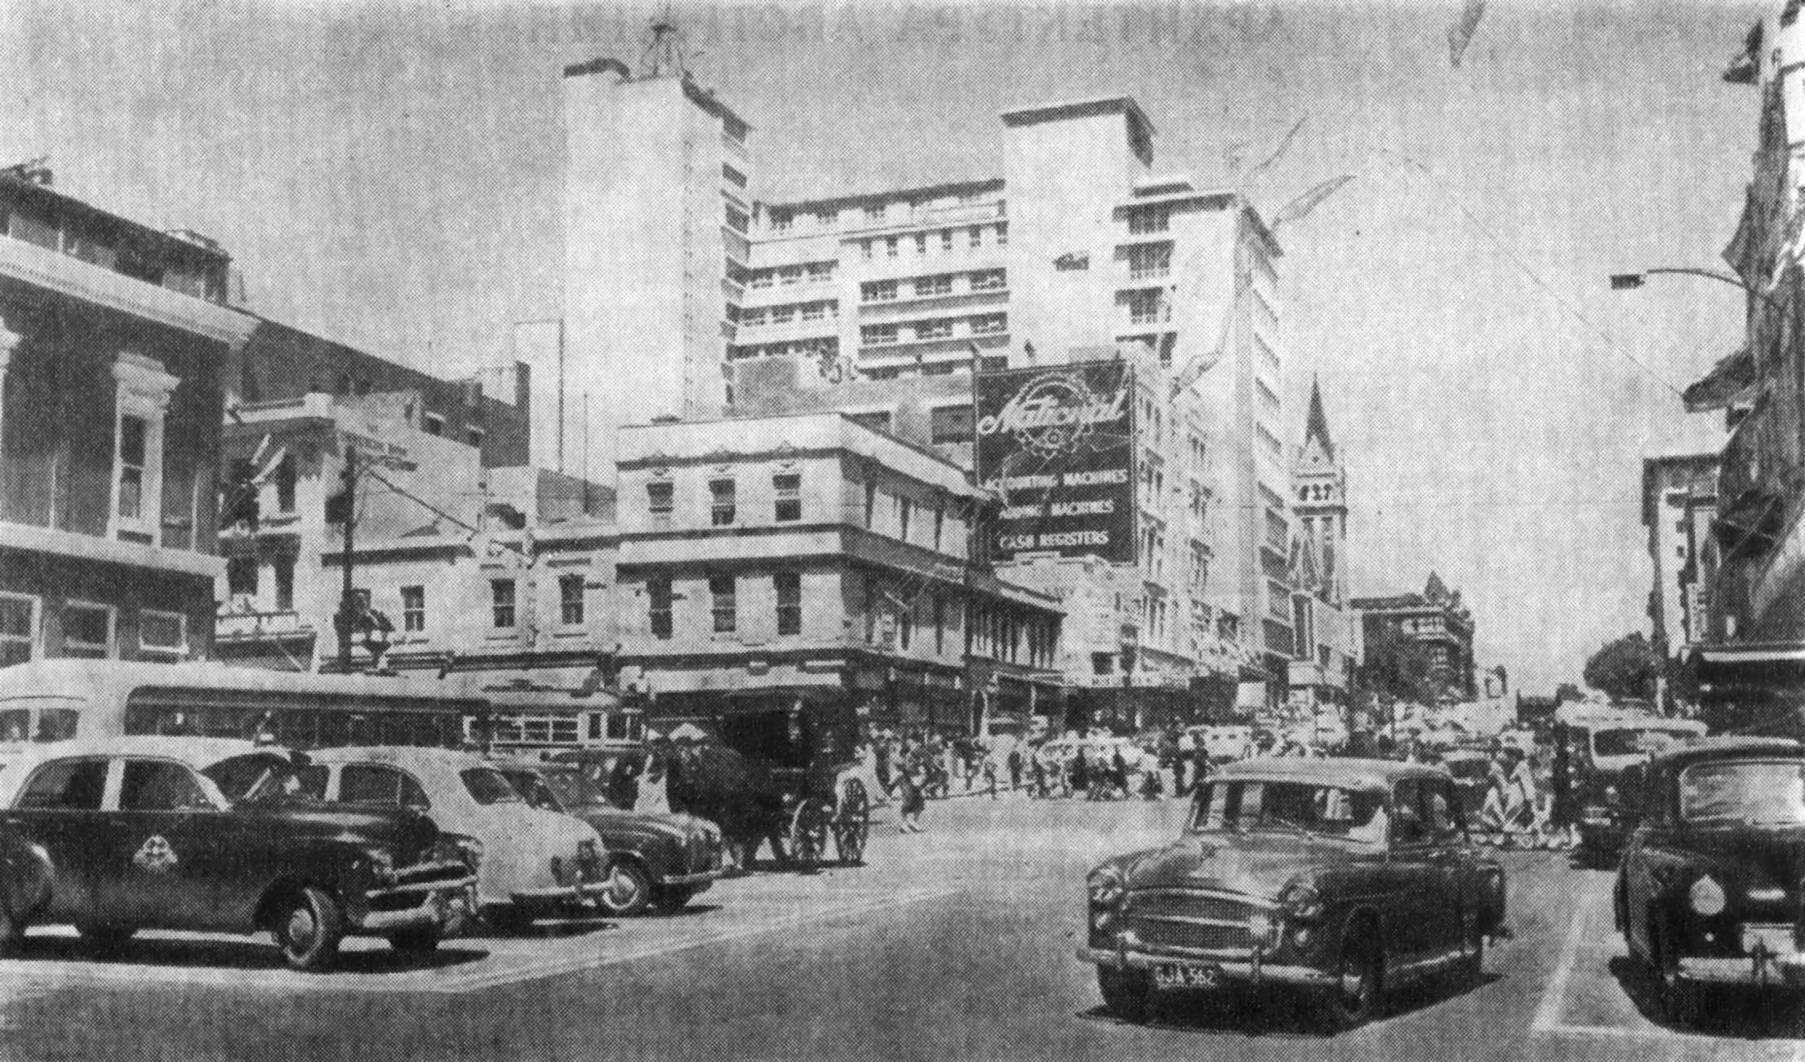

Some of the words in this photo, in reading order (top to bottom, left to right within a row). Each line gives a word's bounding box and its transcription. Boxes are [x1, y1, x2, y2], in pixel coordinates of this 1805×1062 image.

[977, 378, 1129, 434] National
[1063, 470, 1127, 486] MACHINES
[1052, 501, 1114, 516] MACHINES
[999, 535, 1035, 549] CASH
[1040, 531, 1109, 547] REGISTERS
